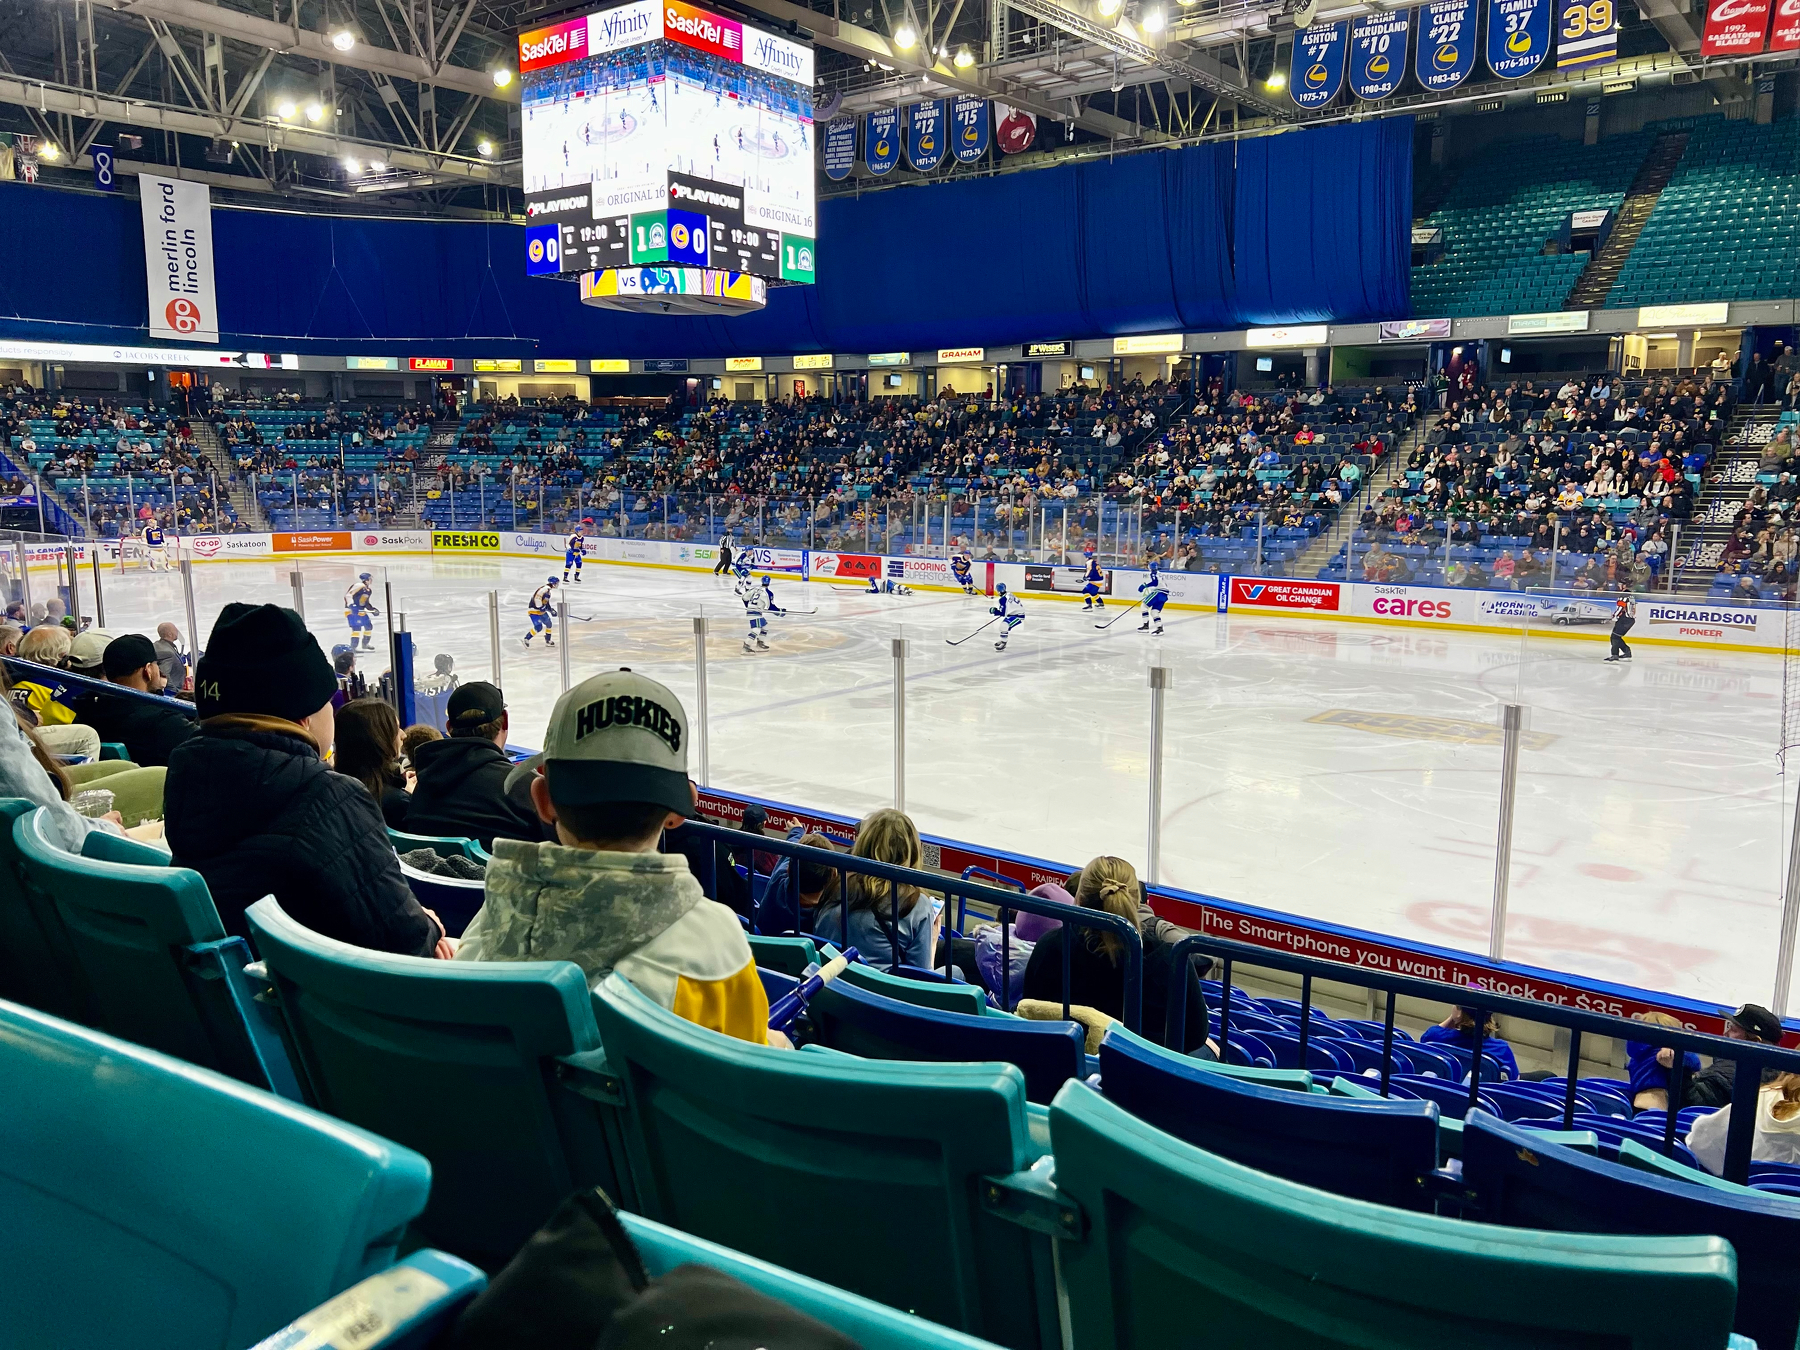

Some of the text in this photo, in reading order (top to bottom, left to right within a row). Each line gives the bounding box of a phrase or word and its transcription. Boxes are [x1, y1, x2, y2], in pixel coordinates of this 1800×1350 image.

[1501, 0, 1537, 14] FAMILY
[666, 7, 721, 43] SaskTel
[1433, 10, 1464, 25] CLARK
[1505, 10, 1533, 33] 37
[1563, 0, 1612, 38] 39
[599, 9, 652, 47] Affinity
[1353, 21, 1408, 38] SKRUDLAND
[1429, 22, 1461, 44] #22
[1724, 24, 1746, 33] 1992
[1302, 32, 1338, 45] ASHTON
[1361, 34, 1390, 54] #10
[1708, 31, 1761, 42] SASKATOON
[1715, 38, 1750, 47] BLADES
[521, 32, 568, 62] SaskTel
[1308, 43, 1329, 62] #7
[754, 37, 803, 76] Affinity
[1495, 54, 1541, 71] 1976-2013
[1428, 71, 1461, 85] 1983-85
[1300, 91, 1328, 102] 1975-79
[1360, 82, 1391, 95] 1980-83
[872, 115, 895, 126] PINDER
[914, 108, 939, 120] BOURNE
[957, 109, 978, 126] #15
[876, 124, 891, 139] #7
[915, 118, 935, 134] #12
[916, 156, 937, 166] 1971-74
[607, 188, 653, 207] ORIGINAL
[655, 185, 666, 199] 16
[679, 184, 740, 210] PLAYNOW
[535, 195, 589, 215] PLAYNOW
[759, 206, 802, 225] ORIGINAL
[803, 215, 813, 228] 16
[158, 182, 180, 293] merlin ford
[580, 224, 608, 242] 19:00
[636, 226, 648, 252] 1
[692, 227, 706, 254] 0
[731, 228, 759, 248] 19:00
[546, 237, 558, 263] 0
[786, 245, 797, 270] 1
[180, 228, 199, 294] lincoln
[590, 253, 598, 268] 2
[740, 257, 748, 271] 2
[622, 276, 636, 287] VS
[174, 298, 200, 333] go
[23, 347, 75, 358] responsibly.
[125, 351, 190, 362] JACOBS CREEK
[941, 349, 981, 359] GRAHAM
[415, 359, 448, 369] FLAMAN
[298, 535, 333, 543] SaskPower
[382, 537, 423, 545] SaskPork
[515, 535, 547, 552] Culligan
[694, 549, 712, 559] SGI
[755, 549, 771, 563] VS
[905, 561, 947, 572] FLOORING
[1268, 586, 1332, 597] GREAT CANADIAN
[1375, 586, 1407, 595] SaskTel
[1276, 594, 1322, 604] OIL CHANGE
[1373, 597, 1452, 619] cares
[1494, 608, 1538, 617] LEASING
[1679, 628, 1723, 637] PIONEER
[200, 679, 221, 701] 14
[574, 694, 682, 754] HUSKIES
[826, 825, 857, 843] Prairi
[1203, 910, 1625, 1019] The Smartphone you want in stock or $35
